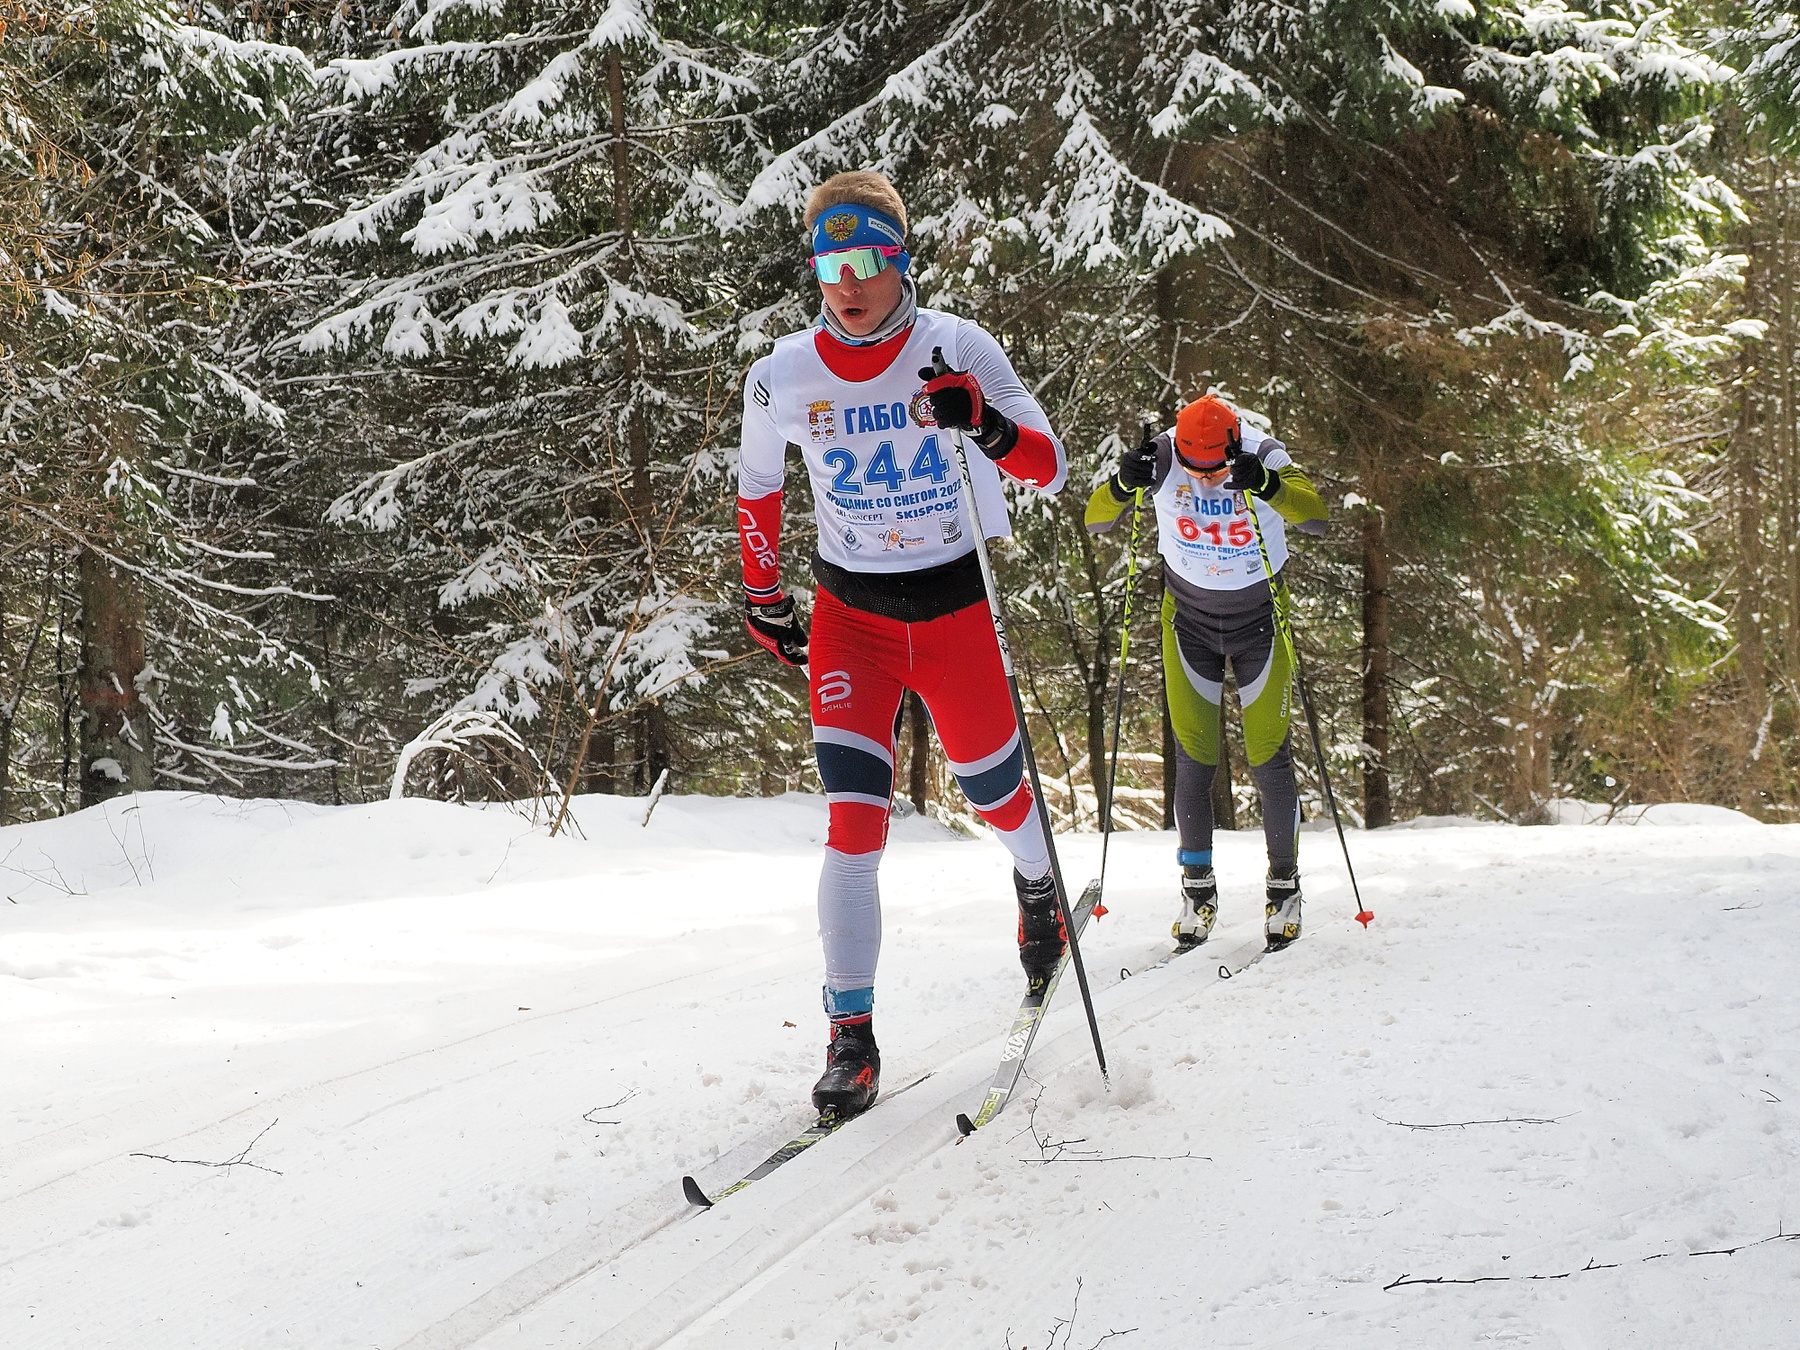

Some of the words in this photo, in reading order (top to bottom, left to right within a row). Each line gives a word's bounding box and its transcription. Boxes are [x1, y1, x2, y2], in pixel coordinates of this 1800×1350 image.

[843, 401, 908, 435] ГАБО
[823, 434, 950, 495] 244
[826, 490, 875, 511] ПРОЩАНИЕ
[876, 497, 893, 509] СО
[894, 488, 938, 507] СНЕГОМ
[896, 497, 959, 521] SKISPORT
[1195, 496, 1233, 516] ГАБО
[1176, 516, 1254, 548] 615
